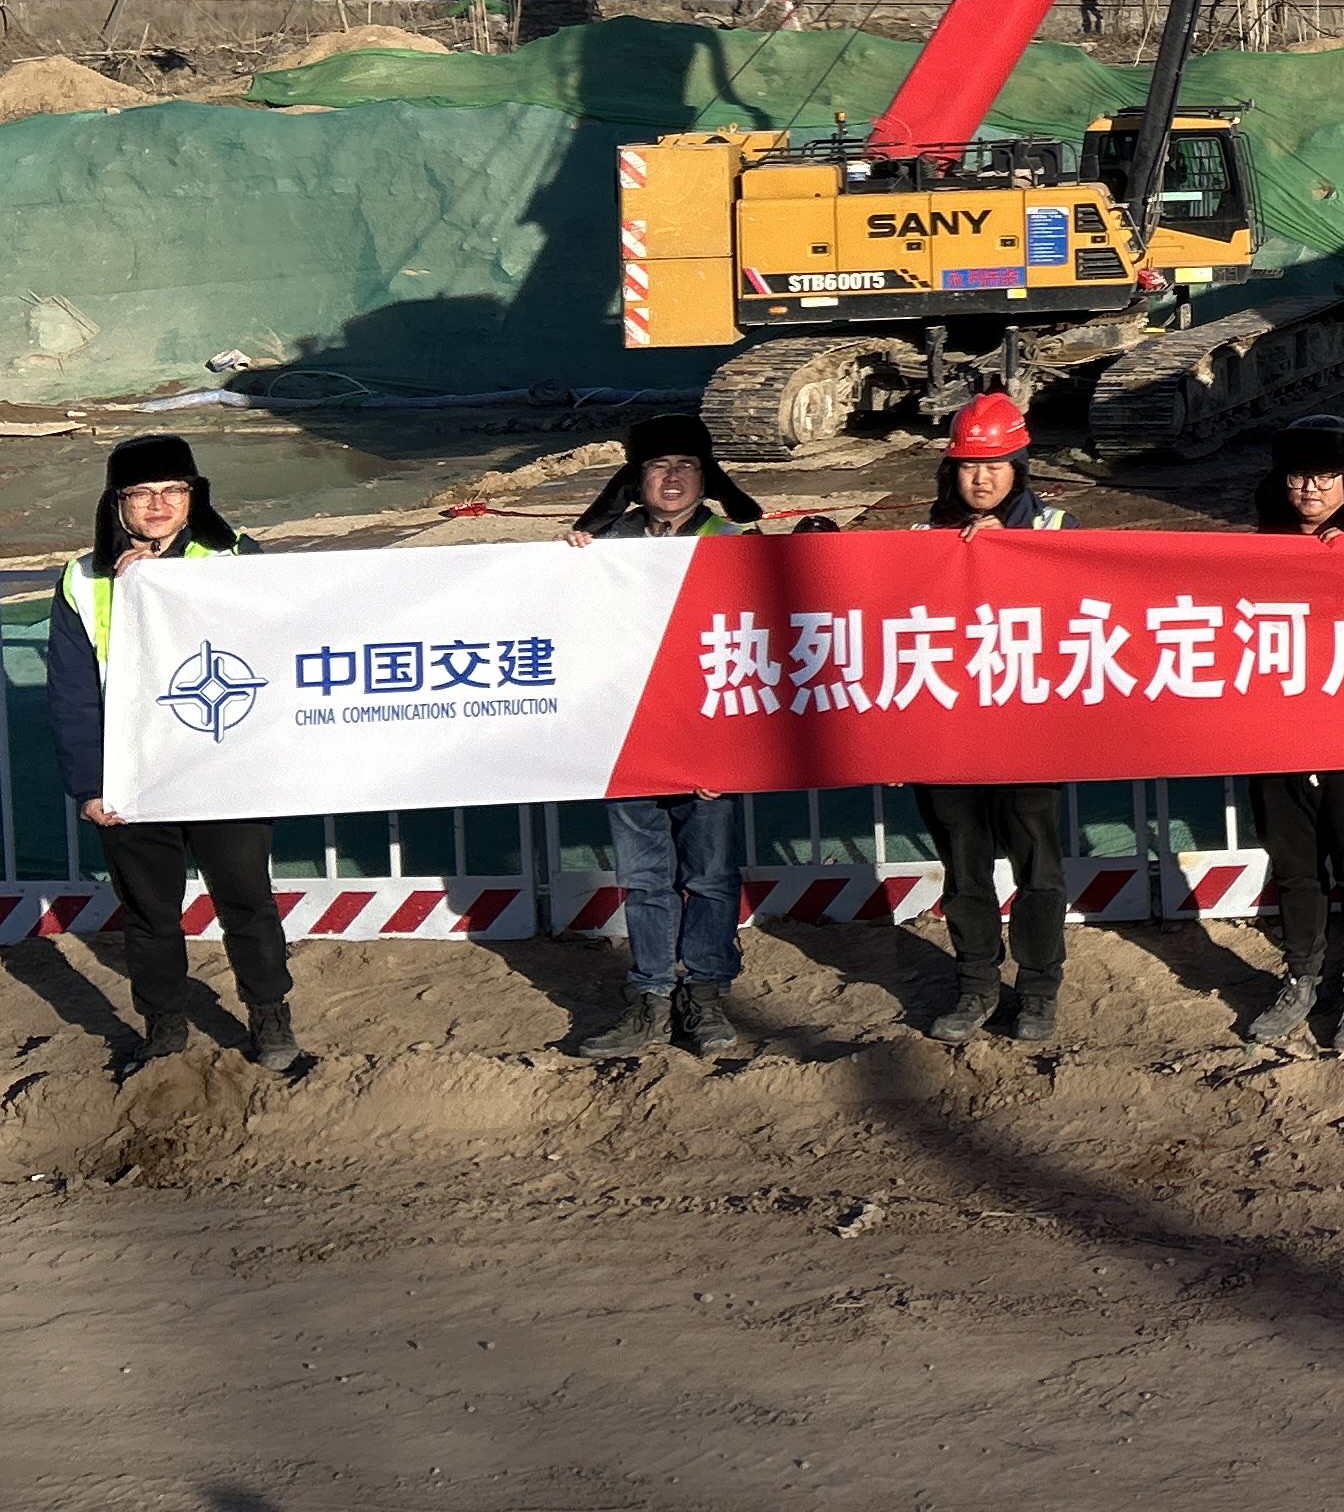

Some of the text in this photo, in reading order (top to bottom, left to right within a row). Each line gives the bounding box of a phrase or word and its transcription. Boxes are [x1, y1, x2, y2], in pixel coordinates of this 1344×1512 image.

[867, 209, 993, 239] SANY
[788, 272, 886, 293] STB600T5
[295, 636, 557, 697] 中国交建
[295, 697, 558, 727] CHINA COMMUNICATIONS CONSTRUCTION
